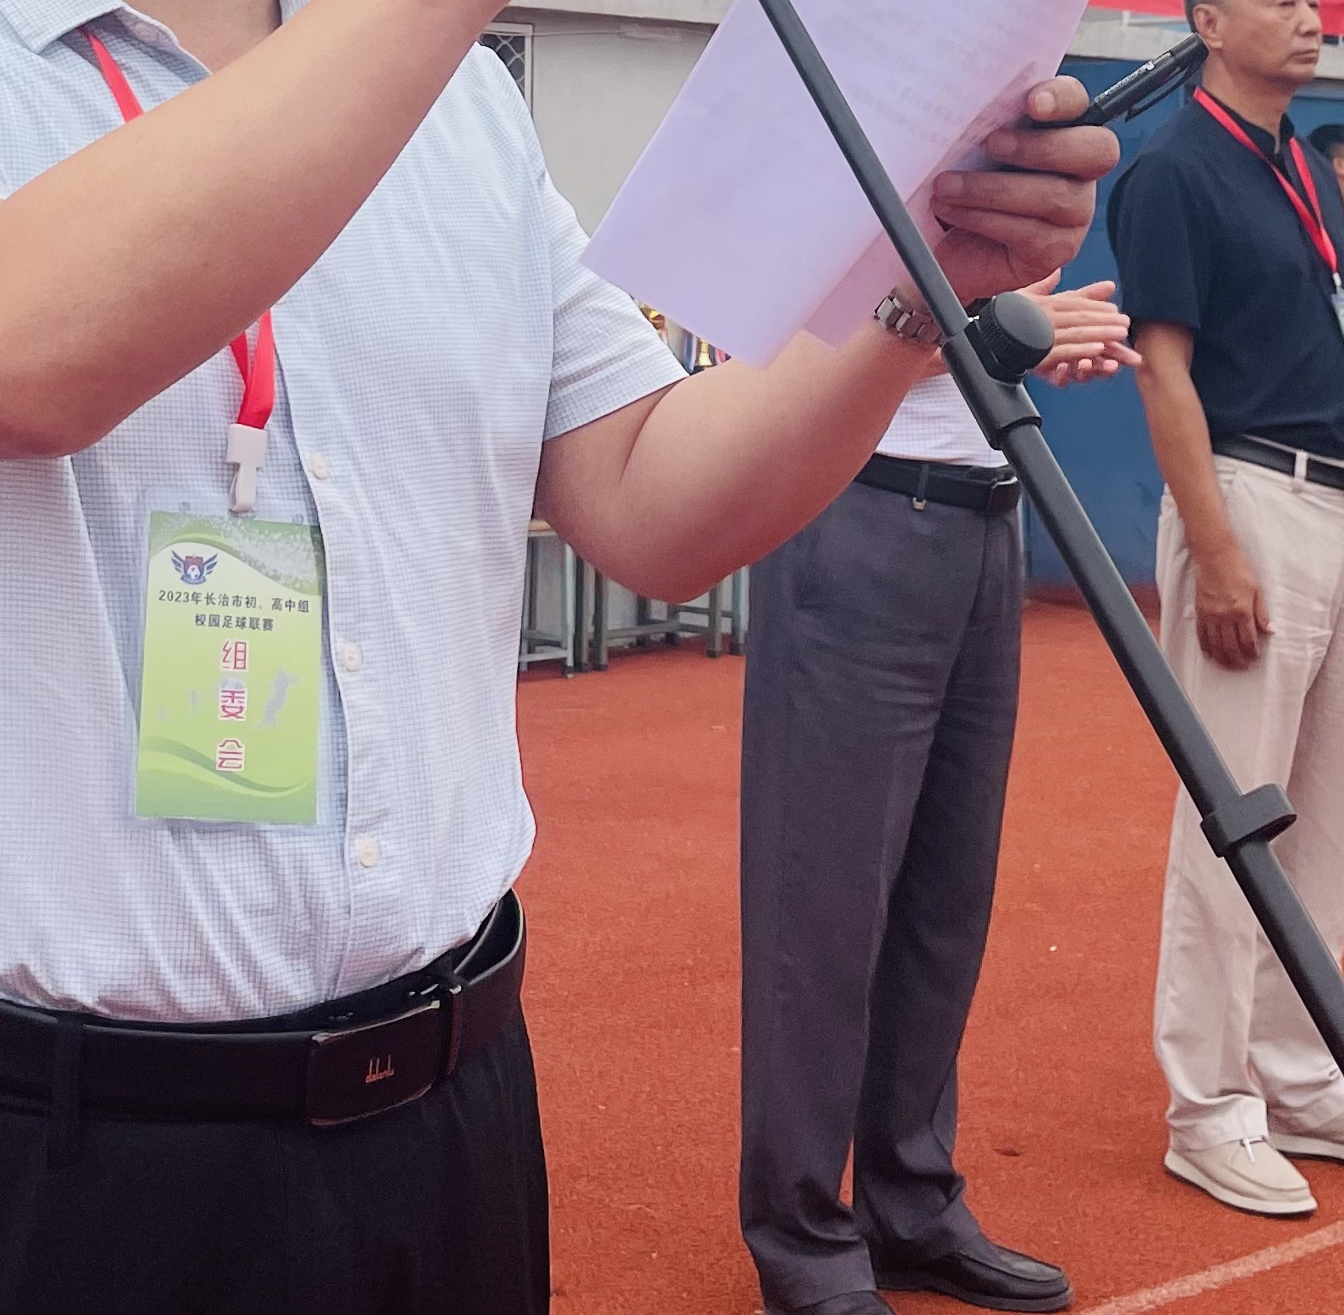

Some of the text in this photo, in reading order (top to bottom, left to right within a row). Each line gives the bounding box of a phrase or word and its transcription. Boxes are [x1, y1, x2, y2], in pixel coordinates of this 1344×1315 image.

[159, 589, 310, 612] 2023年长治市初、高中组
[194, 613, 274, 631] 校园足球联赛
[217, 640, 248, 769] 组委会
